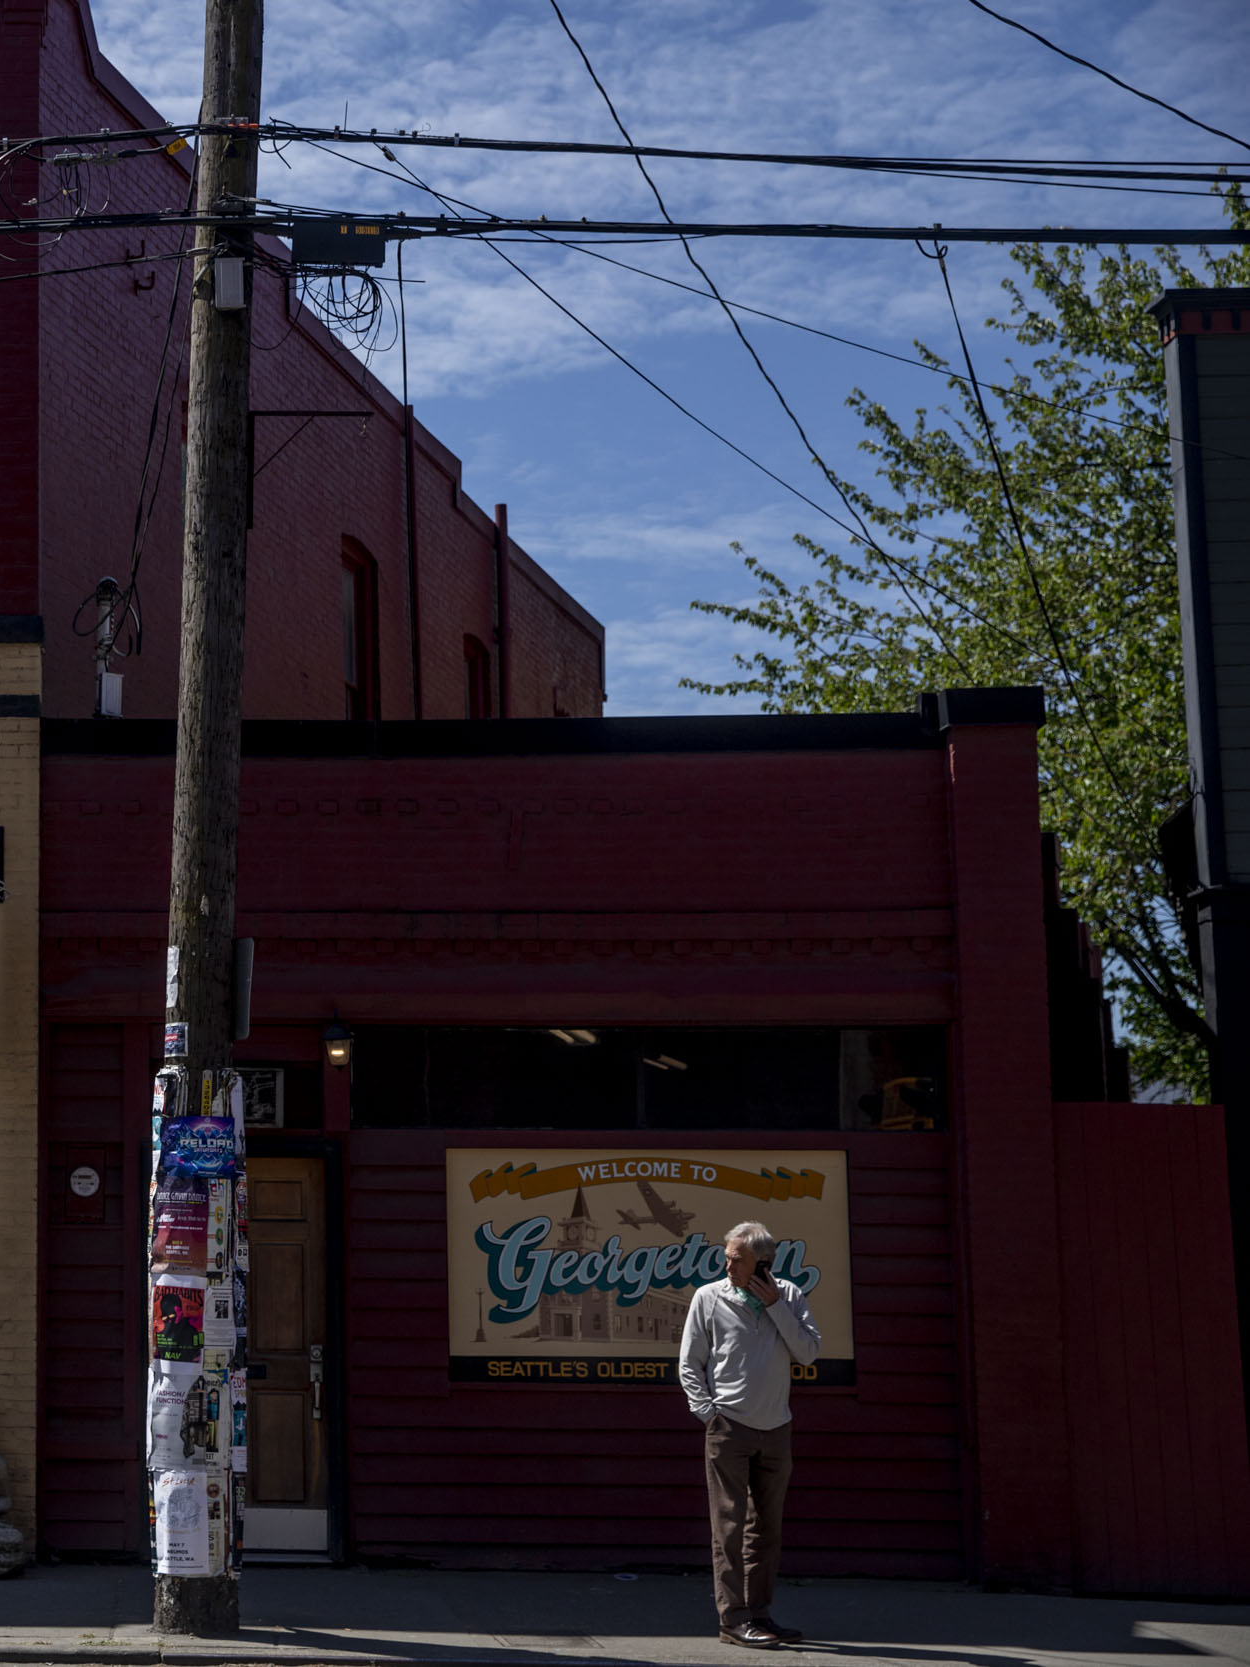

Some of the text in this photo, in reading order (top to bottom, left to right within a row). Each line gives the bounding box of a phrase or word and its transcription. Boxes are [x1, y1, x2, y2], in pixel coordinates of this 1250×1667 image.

[179, 1138, 234, 1150] RELOAD
[577, 1161, 718, 1184] WELCOME TO
[475, 1216, 821, 1323] Georgeton
[164, 1351, 182, 1360] NAV
[486, 1359, 589, 1378] SEATTLE'S
[596, 1361, 670, 1380] OLDEST
